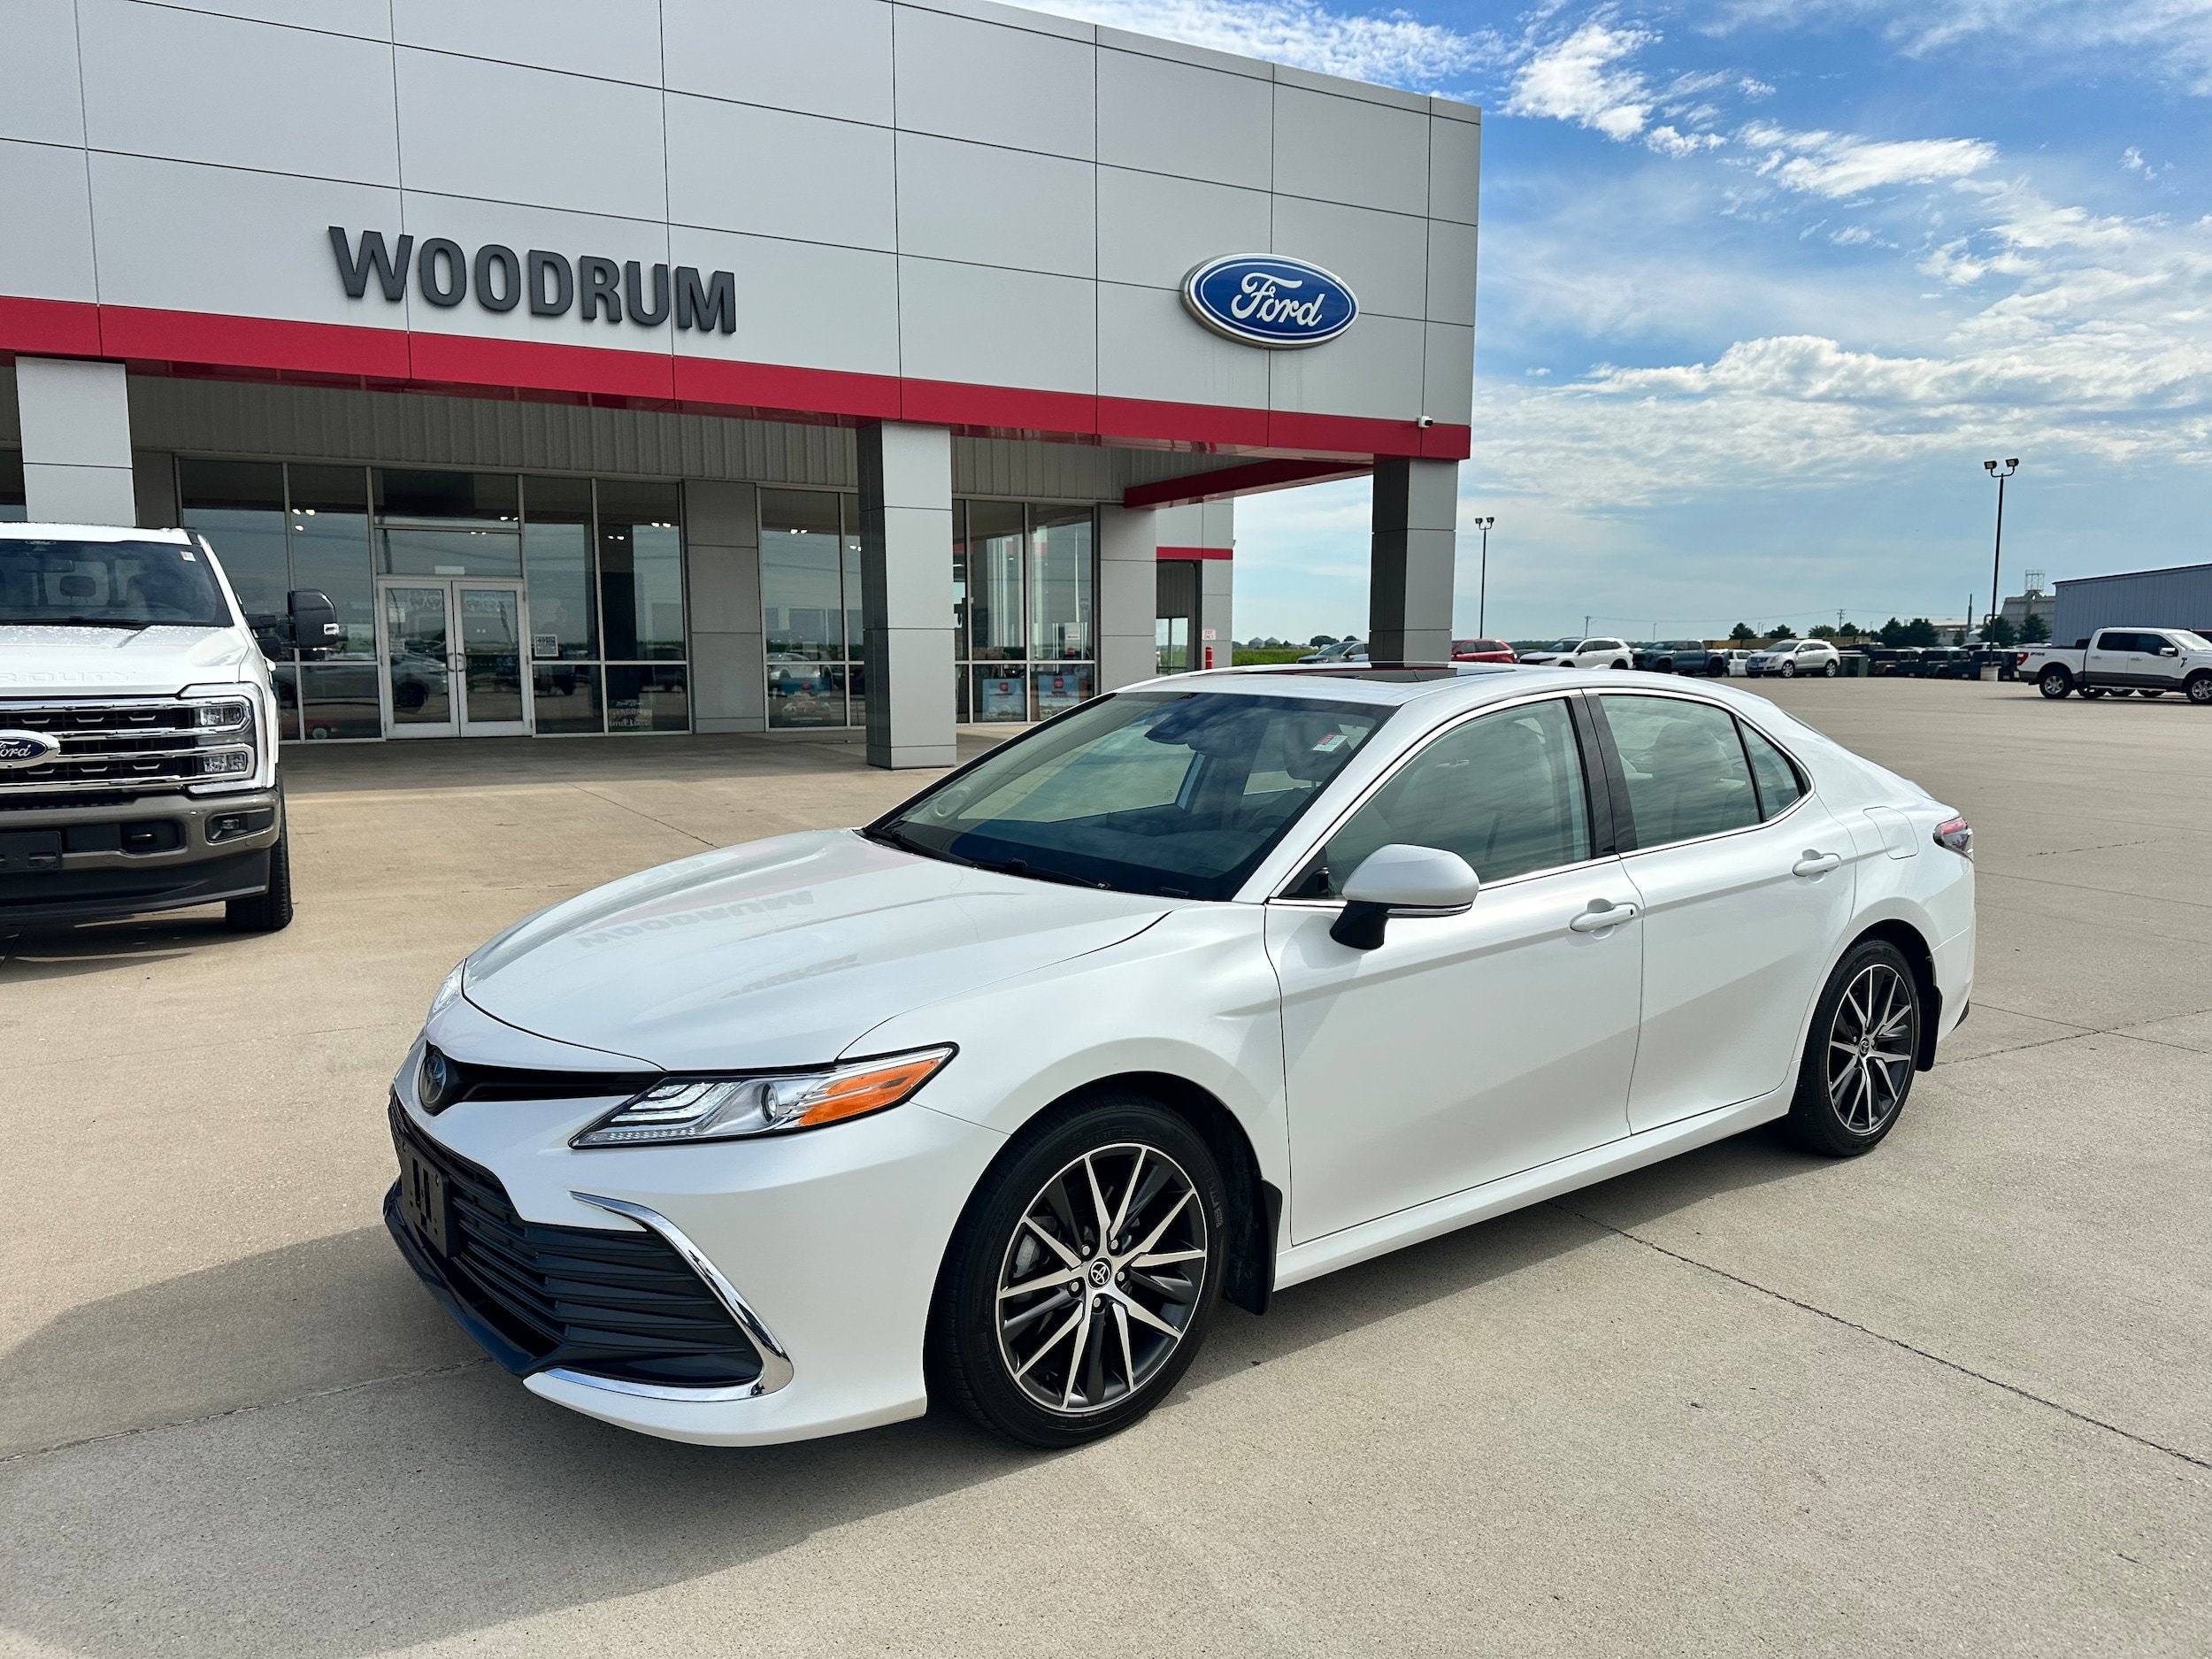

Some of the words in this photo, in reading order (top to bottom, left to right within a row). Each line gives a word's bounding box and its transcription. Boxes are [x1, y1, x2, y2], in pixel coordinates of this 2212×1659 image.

[327, 225, 736, 334] WOODRUM
[1231, 272, 1325, 327] Ford
[27, 671, 136, 681] DUTY
